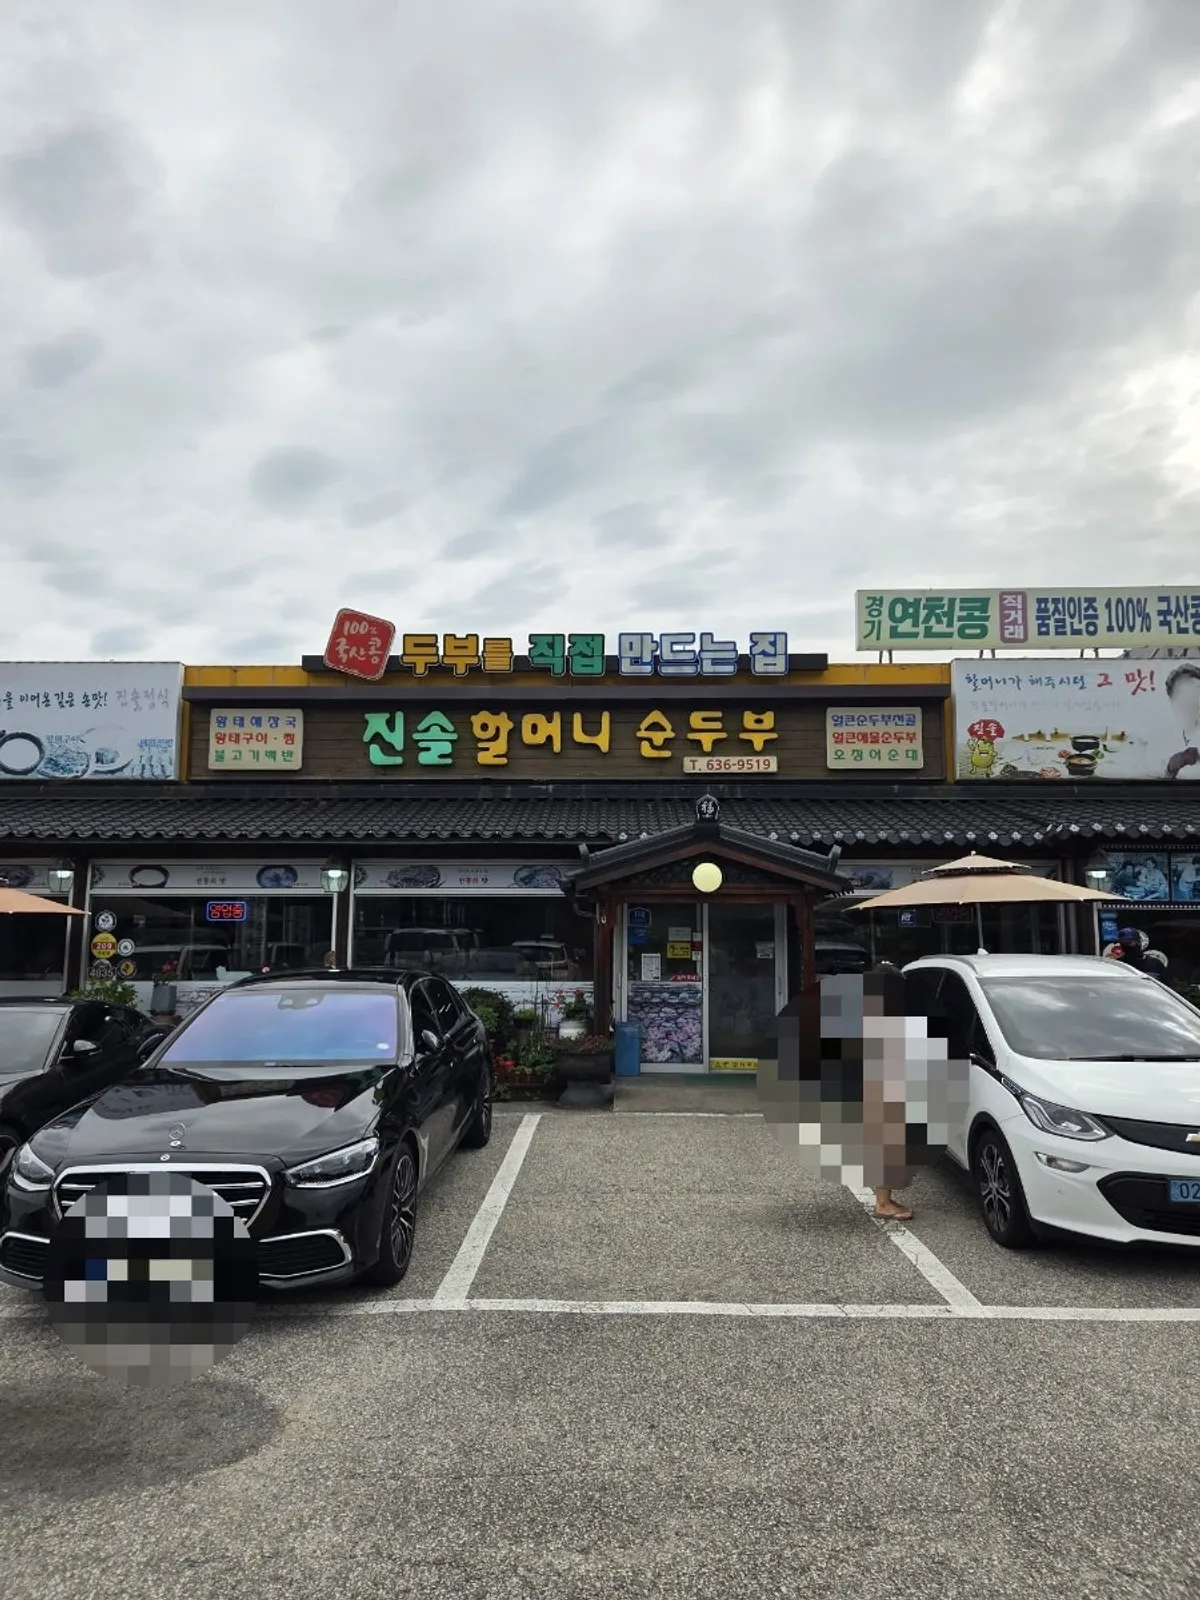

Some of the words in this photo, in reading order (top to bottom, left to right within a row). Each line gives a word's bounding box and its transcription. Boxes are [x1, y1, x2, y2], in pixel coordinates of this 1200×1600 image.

[863, 595, 884, 641] 경기
[888, 596, 991, 640] 연천콩
[1002, 594, 1025, 640] 직거래
[1035, 596, 1099, 637] 품질인증
[1105, 597, 1152, 634] 100%
[343, 620, 378, 636] 100%
[401, 633, 513, 677] 두부를
[528, 633, 605, 677] 직접
[618, 632, 738, 677] 만드는
[750, 632, 789, 676] 집
[965, 673, 1022, 692] 할머니가
[1097, 672, 1113, 688] 그
[1125, 668, 1156, 696] 맛!
[0, 691, 14, 711] 을
[831, 714, 916, 727] 얼큰순두부전골
[363, 711, 459, 766] 진솔
[470, 710, 611, 766] 할머니
[636, 709, 779, 759] 순두부
[832, 731, 917, 744] 얼큰해물순두부
[214, 749, 294, 763] 불고기백반
[706, 758, 771, 771] 636-9519
[833, 748, 918, 762] 오징어순대
[209, 904, 244, 919] 영업중
[1180, 1182, 1200, 1200] 02
